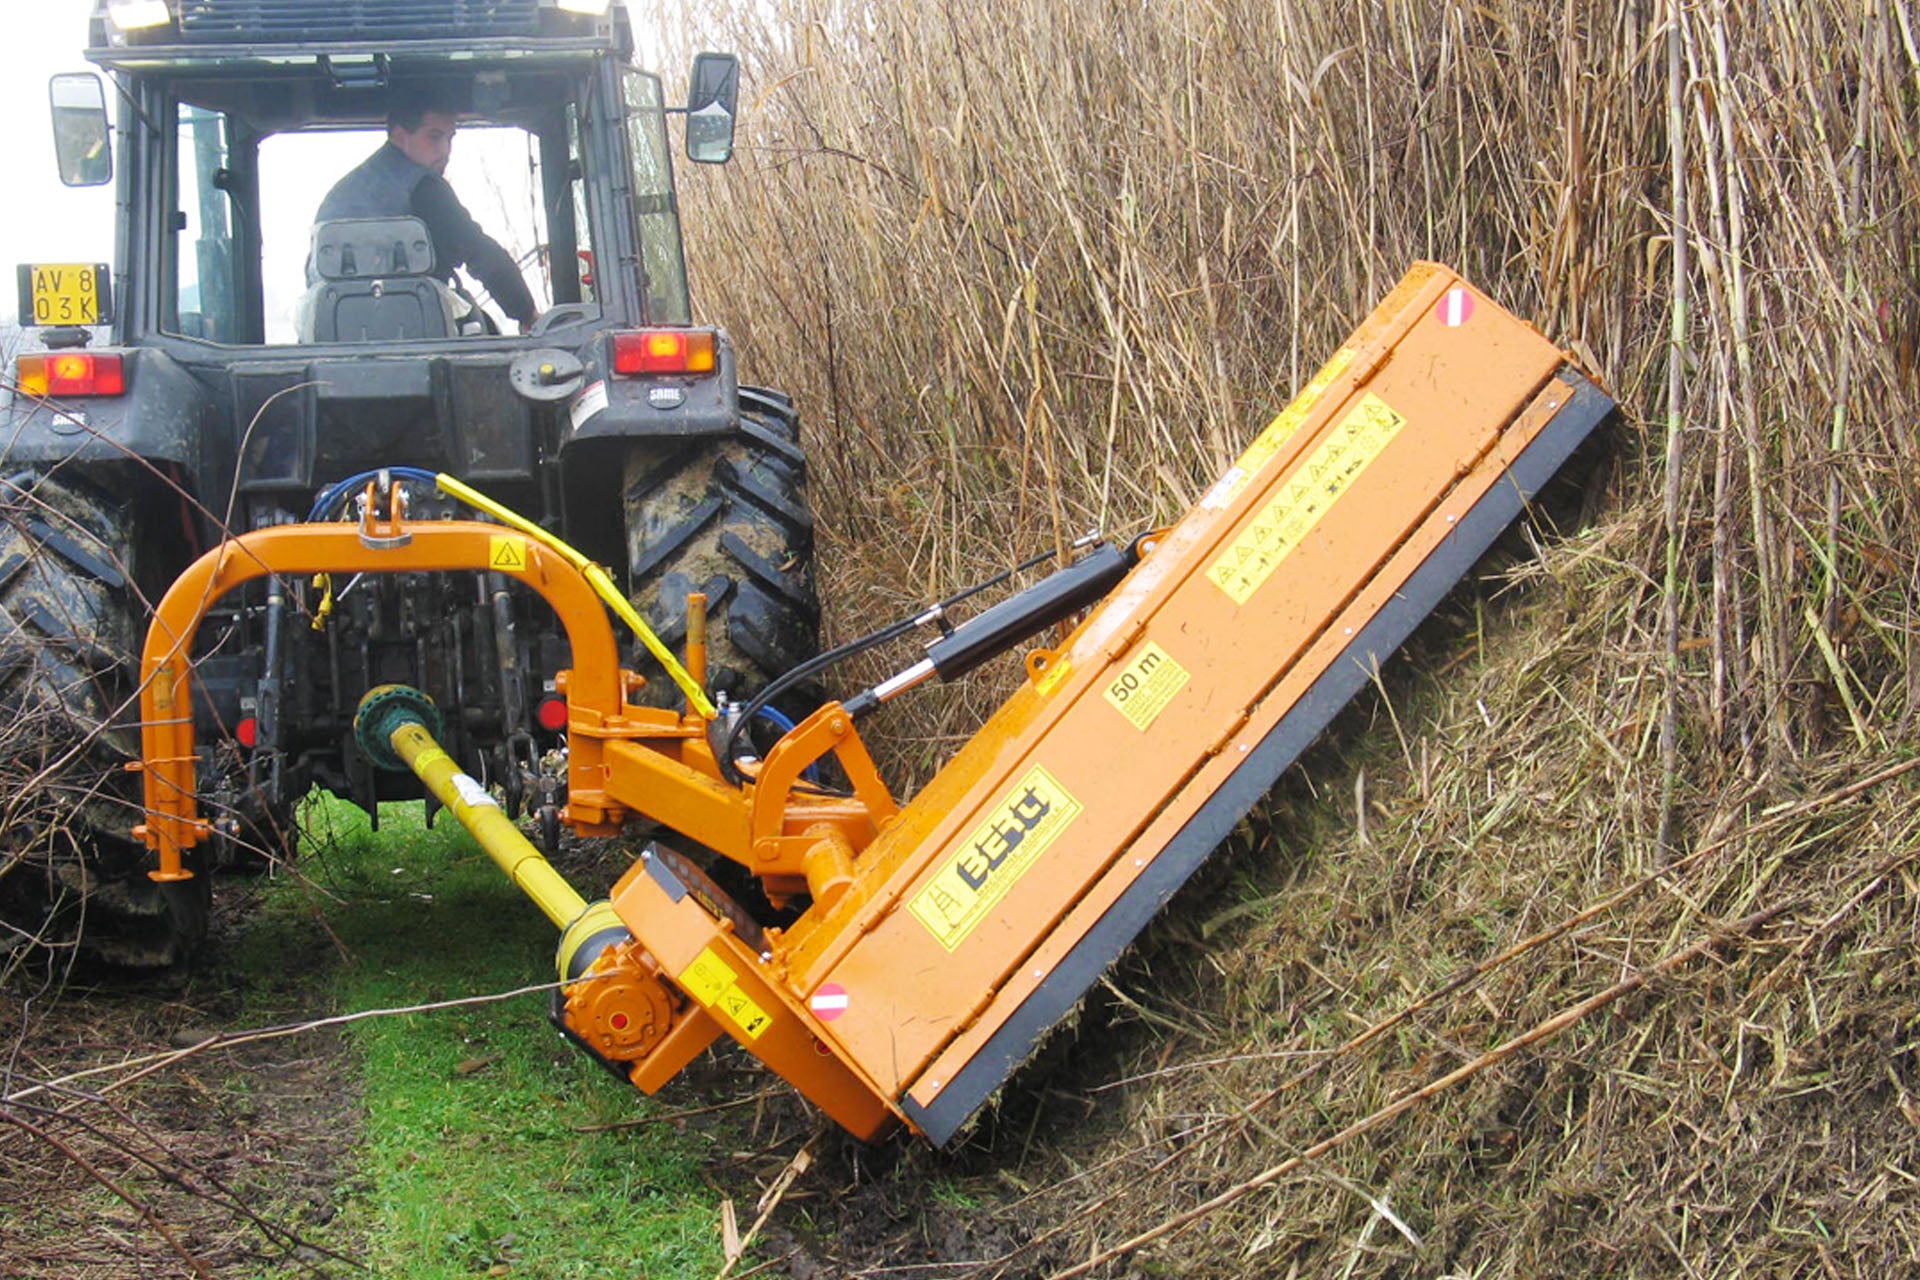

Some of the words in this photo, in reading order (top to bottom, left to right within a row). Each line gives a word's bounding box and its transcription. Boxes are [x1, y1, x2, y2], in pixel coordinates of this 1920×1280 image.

[36, 270, 62, 293] AV
[79, 269, 93, 293] 8
[650, 387, 680, 401] SAME
[1111, 673, 1139, 702] 50
[1138, 652, 1161, 675] m
[957, 786, 1051, 891] BERTI
